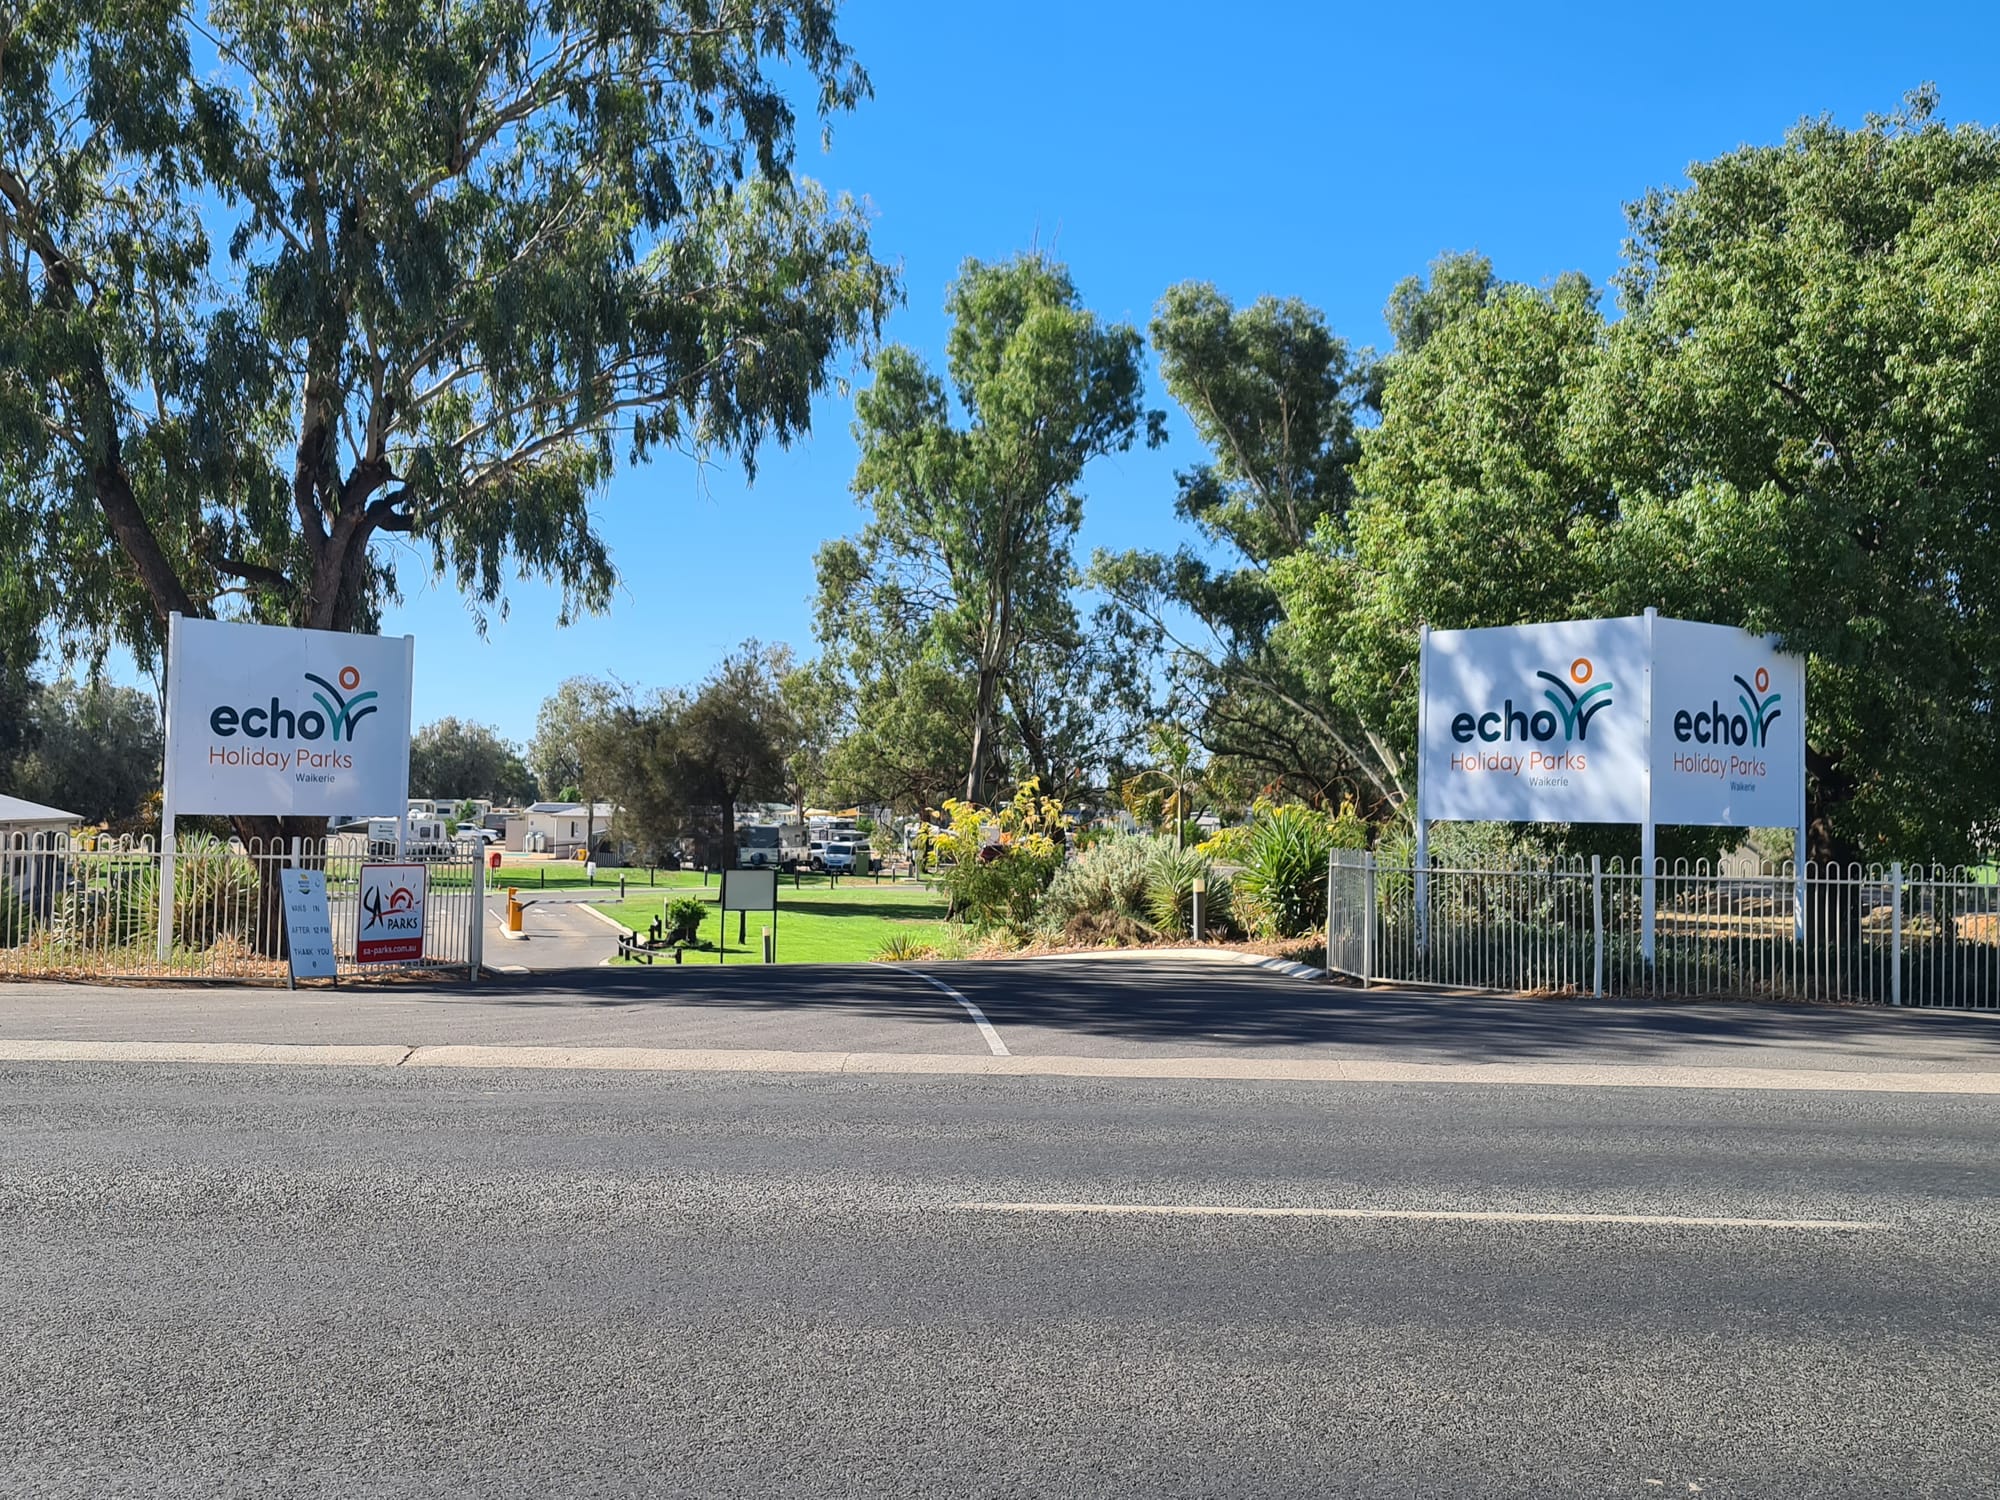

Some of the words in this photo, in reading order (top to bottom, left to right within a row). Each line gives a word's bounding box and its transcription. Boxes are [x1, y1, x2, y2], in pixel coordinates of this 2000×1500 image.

[210, 697, 326, 741] echo
[1451, 700, 1557, 743] echo
[1674, 700, 1748, 747] echo
[209, 746, 291, 771] Holiday
[296, 748, 353, 768] Parks
[1450, 752, 1525, 775] Holiday
[1530, 751, 1587, 770] Parks
[1674, 752, 1727, 779] Holiday
[1731, 755, 1767, 776] Parks
[295, 772, 336, 783] Waikerie
[1529, 776, 1569, 787] Waikerie
[1729, 780, 1756, 792] Waikerie
[363, 885, 384, 931] SA
[291, 926, 310, 934] AFTER
[387, 917, 418, 930] PARKS
[294, 948, 314, 956] THANK
[317, 948, 330, 956] YOU
[363, 944, 417, 957] sa-parks.com.au
